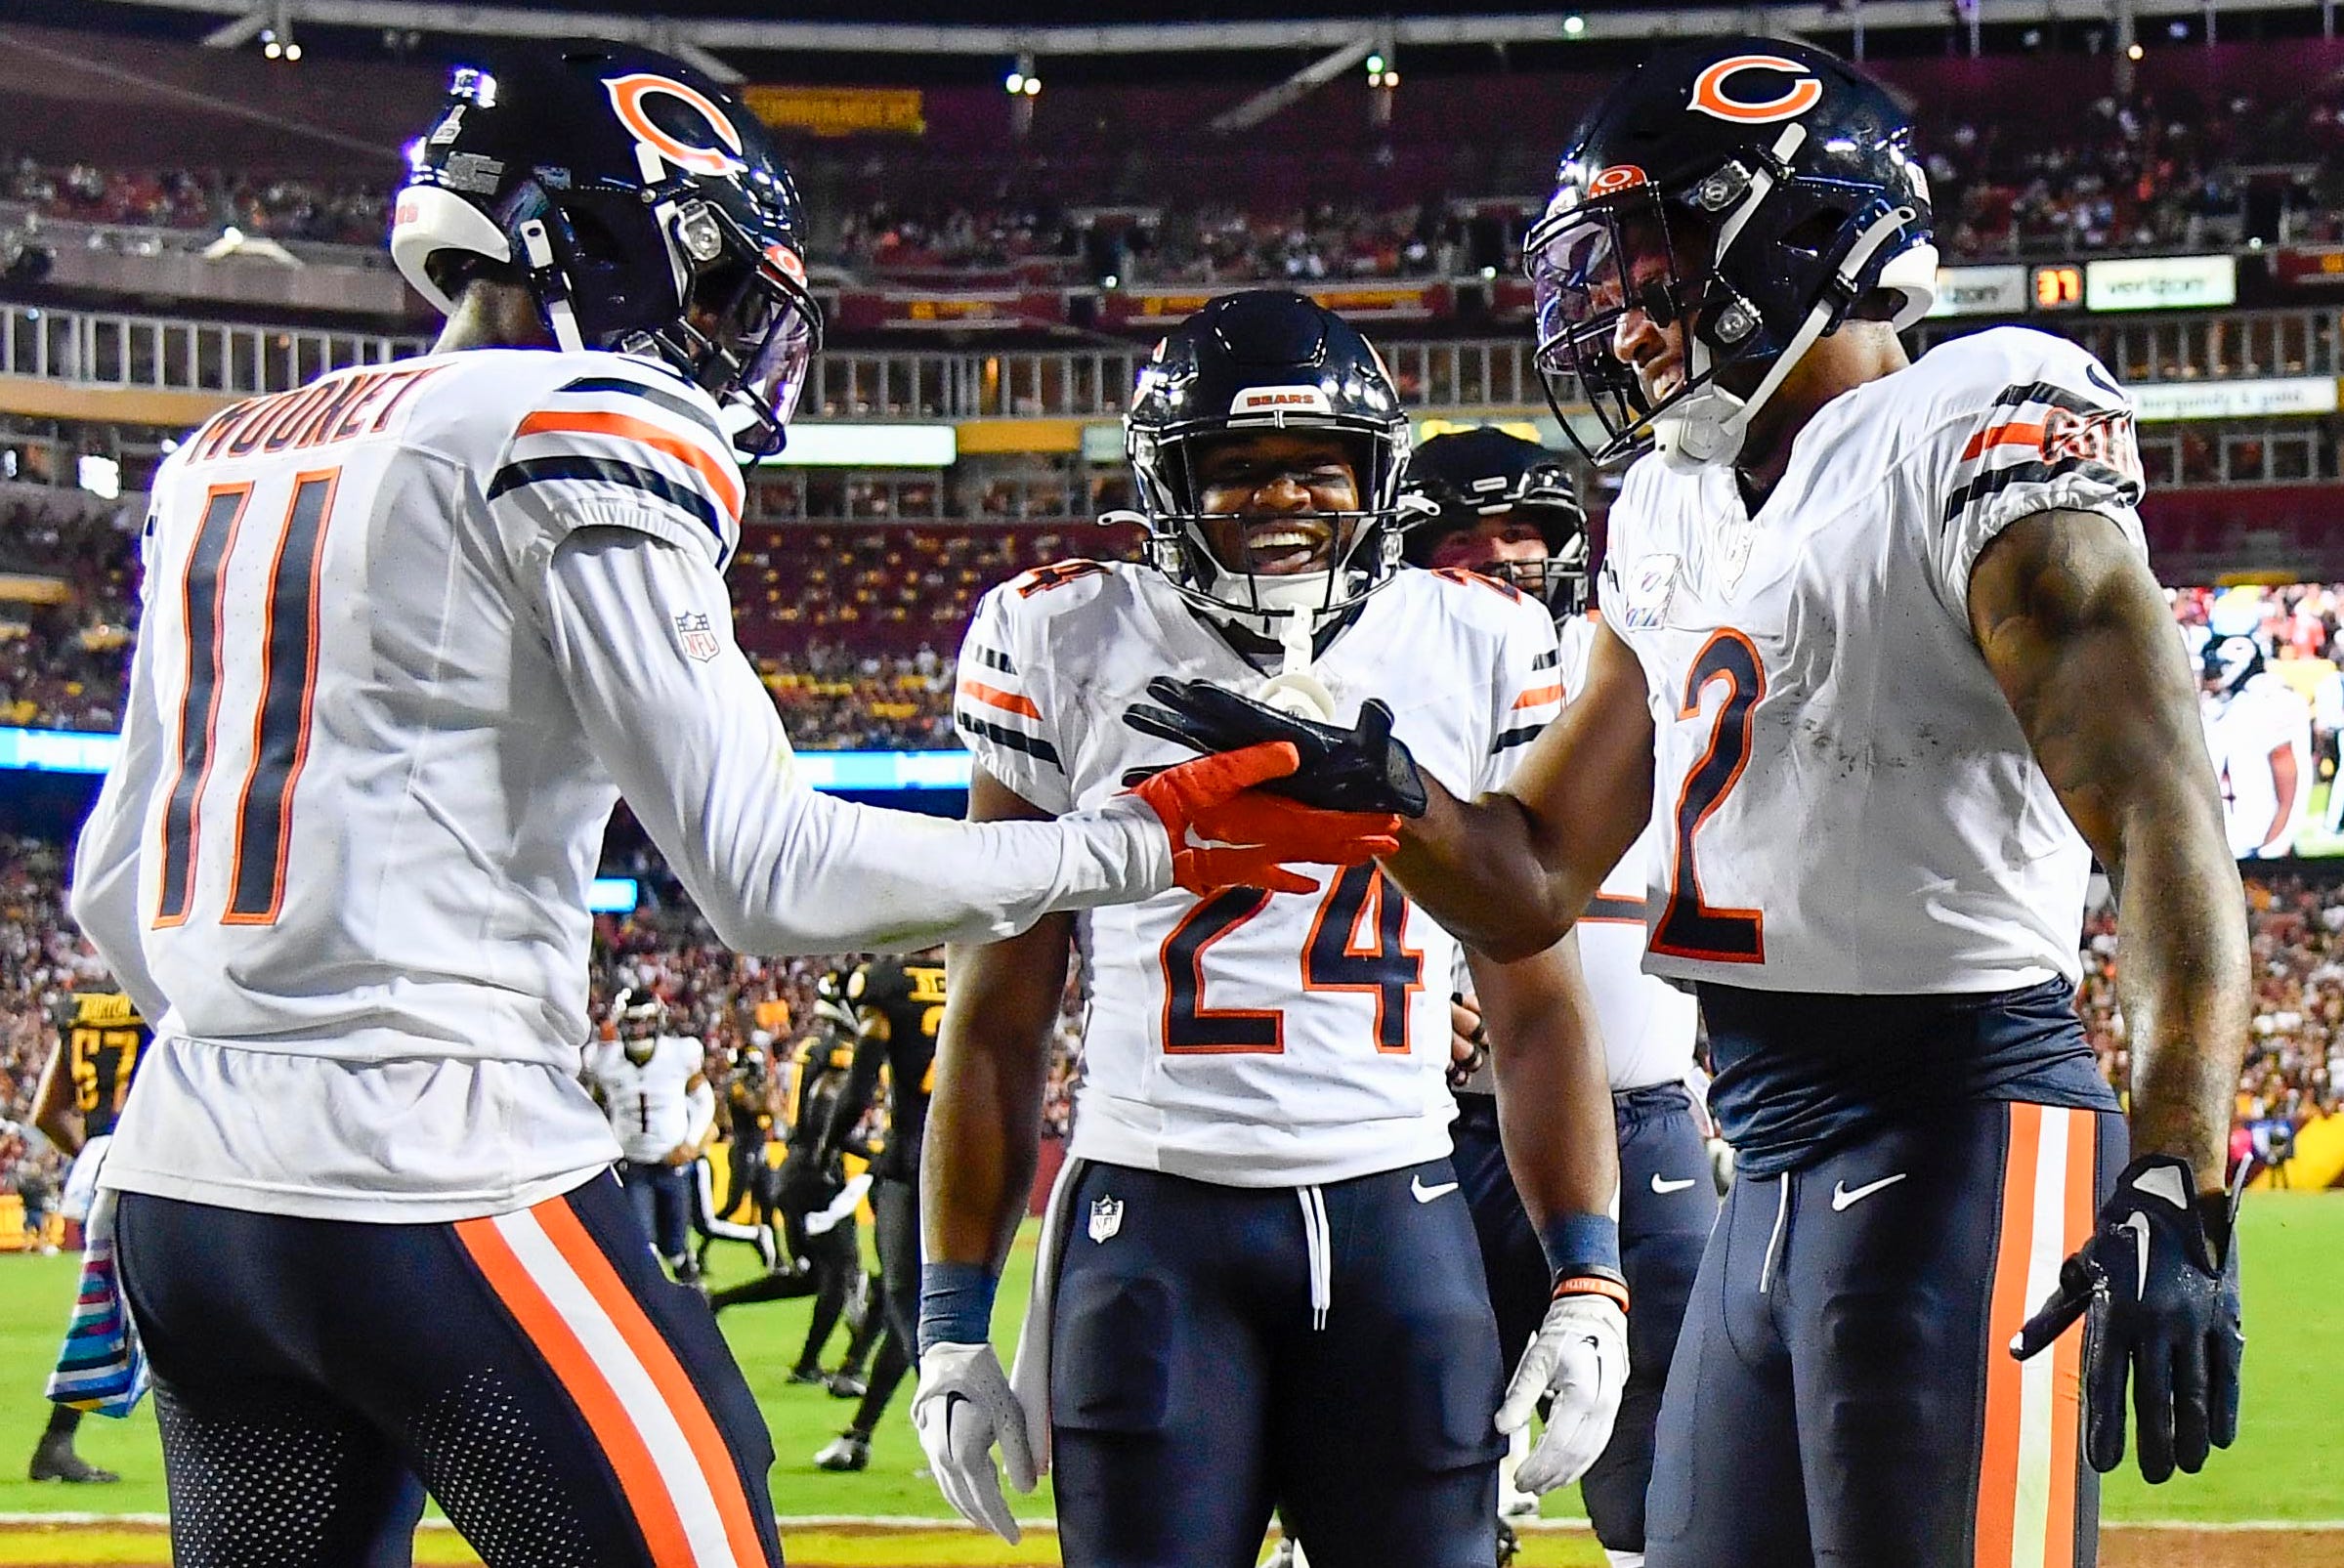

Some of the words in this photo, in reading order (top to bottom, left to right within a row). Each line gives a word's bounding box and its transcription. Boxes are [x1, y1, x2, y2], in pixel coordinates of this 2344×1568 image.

[1247, 395, 1314, 407] BEARS
[151, 467, 342, 929] 11
[684, 633, 717, 657] NFL
[1648, 626, 1766, 964] 2
[1160, 858, 1426, 1054] 24
